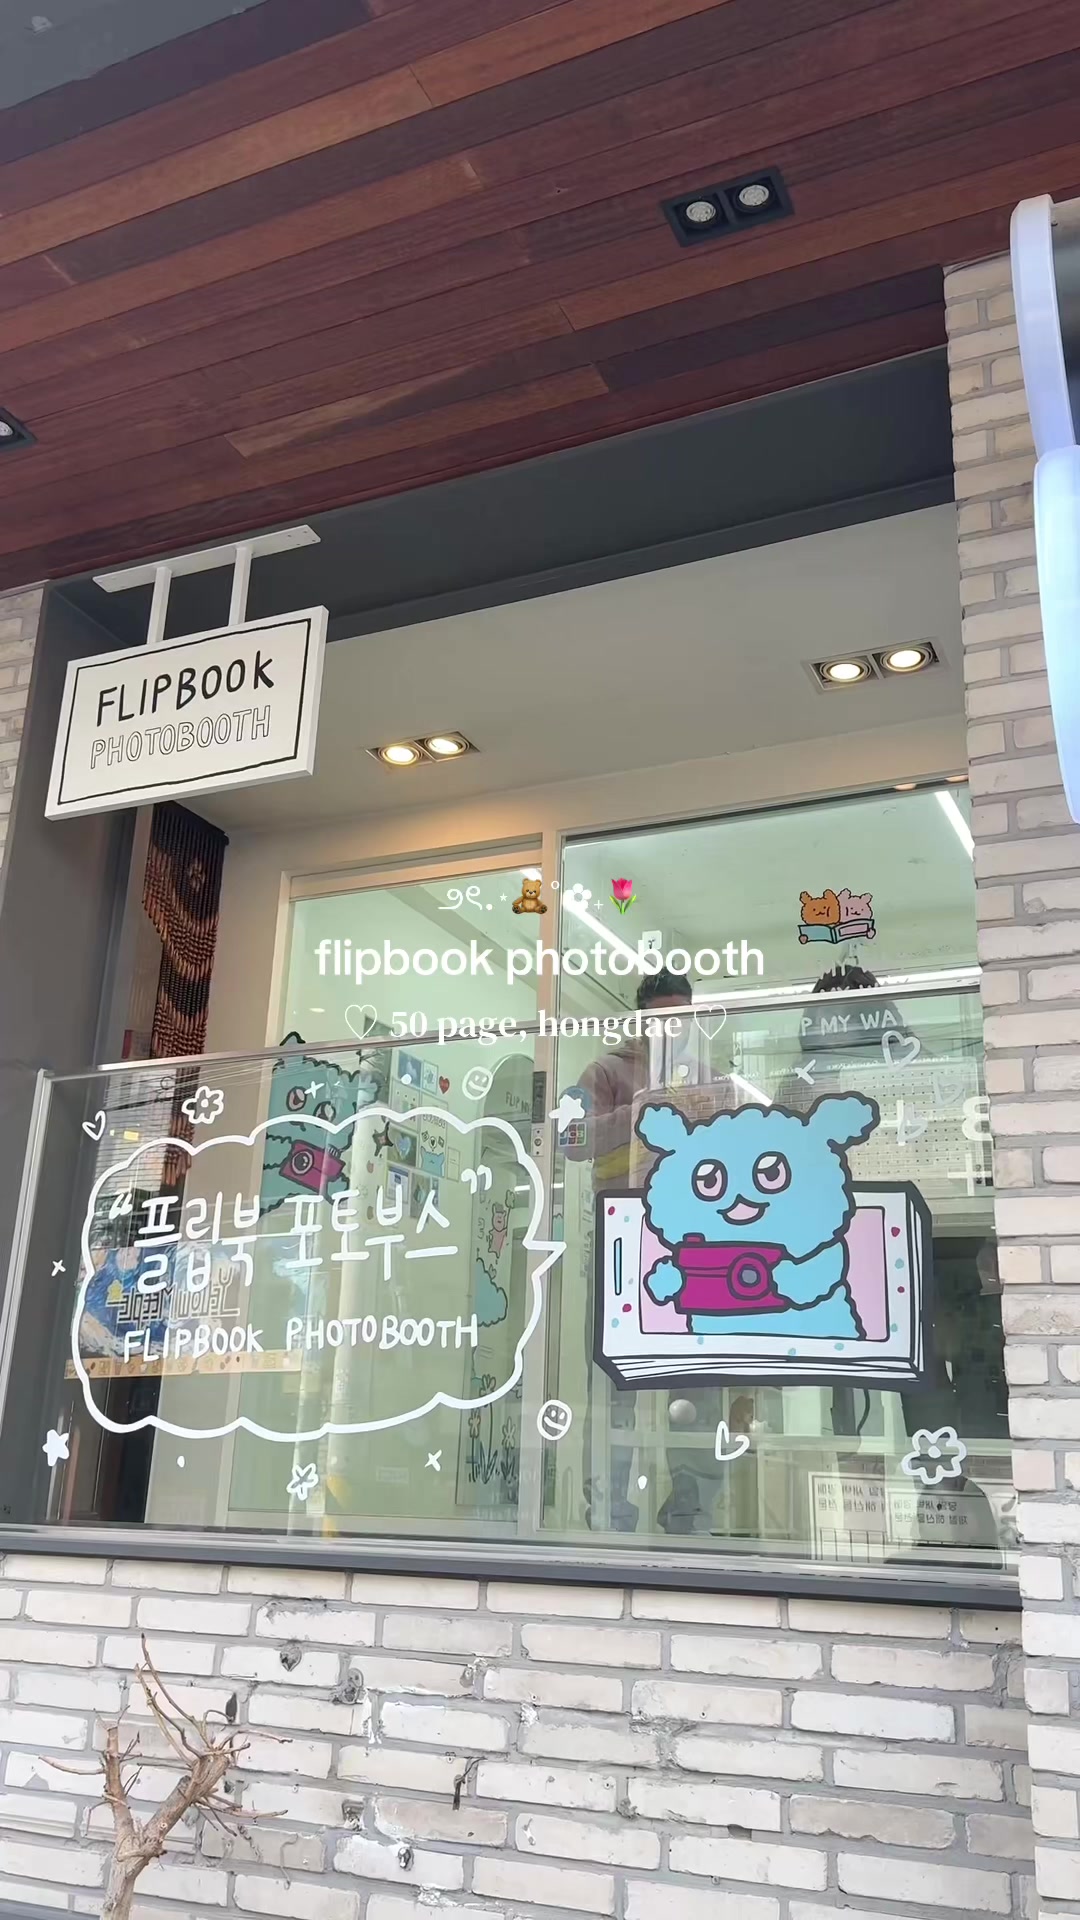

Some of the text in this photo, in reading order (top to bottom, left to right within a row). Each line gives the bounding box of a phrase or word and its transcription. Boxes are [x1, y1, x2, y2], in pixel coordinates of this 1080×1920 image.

[96, 650, 275, 727] FLIPBOOK
[89, 704, 271, 770] PHOTOBOOTH
[820, 1014, 851, 1036] MY
[122, 1313, 479, 1364] FLIPBOOK PHOTOBOOTH
